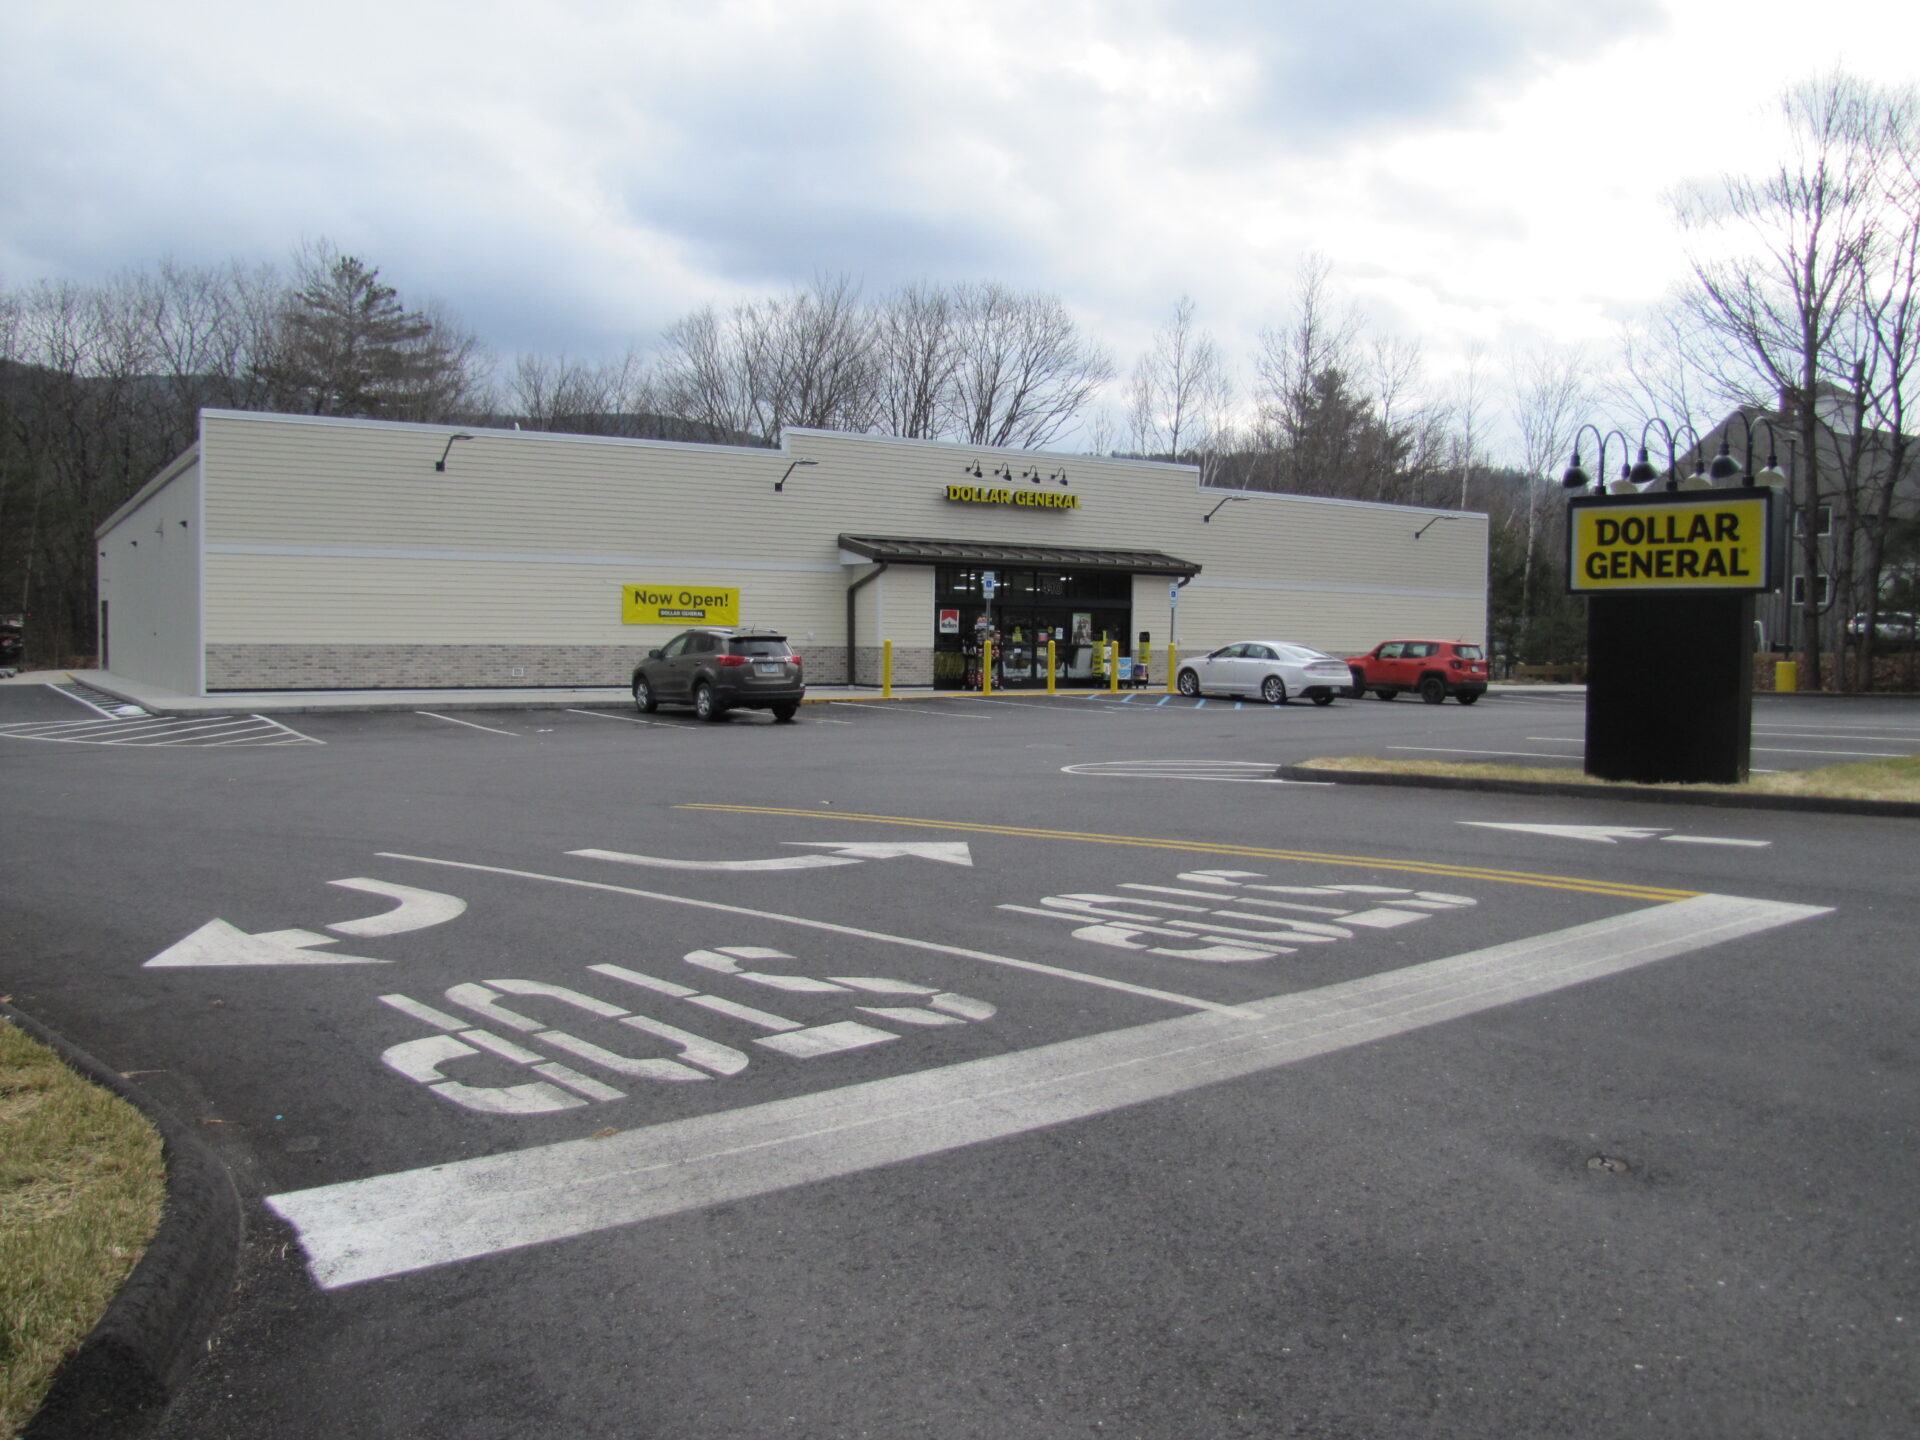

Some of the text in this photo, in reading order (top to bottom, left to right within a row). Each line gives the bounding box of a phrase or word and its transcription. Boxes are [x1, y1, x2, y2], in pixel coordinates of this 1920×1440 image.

[947, 485, 1082, 509] DOLLAR GENERAL
[1595, 512, 1740, 546] DOLLAR
[1585, 547, 1750, 580] GENERAL
[635, 590, 729, 608] Now Open!
[995, 869, 1478, 962] STOP
[380, 946, 998, 1115] STOP
